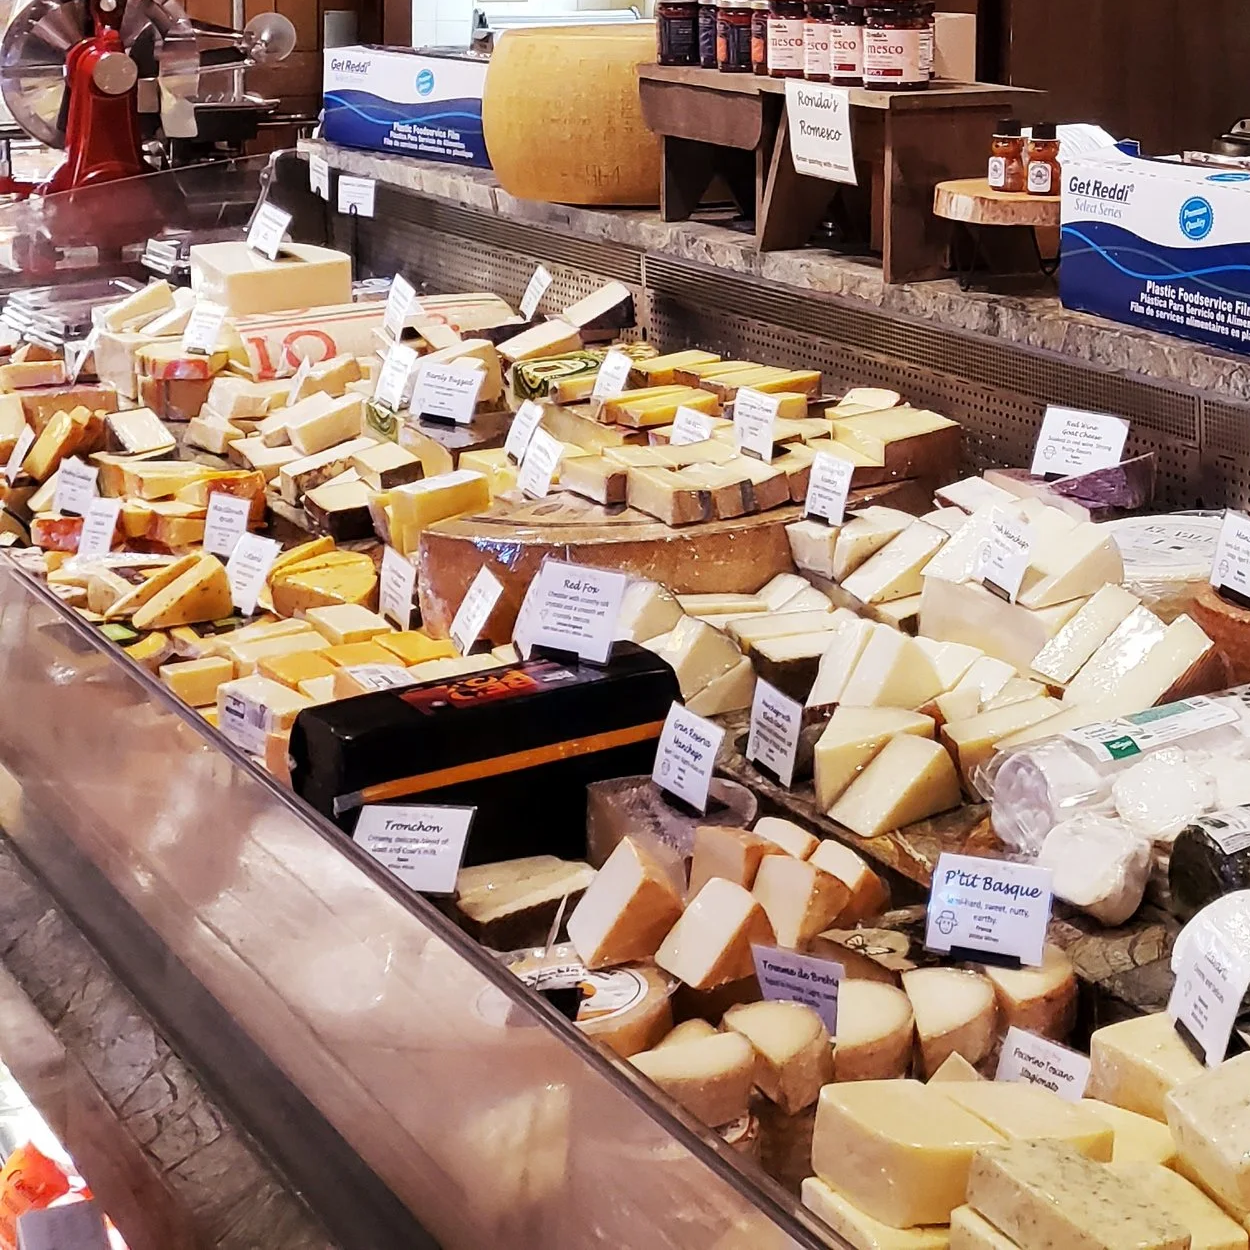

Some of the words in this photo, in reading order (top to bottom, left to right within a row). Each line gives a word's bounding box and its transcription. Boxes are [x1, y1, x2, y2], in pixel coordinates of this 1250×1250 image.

[797, 90, 840, 112] Ronda's
[799, 119, 842, 141] Romesco
[1069, 176, 1091, 196] Get
[1074, 197, 1097, 214] Select
[1100, 202, 1123, 219] Series
[1146, 280, 1177, 300] Plastic
[1178, 287, 1233, 313] Foodservice
[1130, 301, 1145, 314] Film
[1146, 305, 1155, 317] de
[1155, 309, 1184, 325] services
[1186, 316, 1229, 336] alimentaires
[1231, 328, 1240, 338] en
[1168, 299, 1185, 312] Para
[1186, 303, 1215, 321] Servicio
[1216, 311, 1226, 323] de
[563, 579, 582, 591] Red
[582, 582, 600, 594] Fox
[385, 820, 443, 833] Tronchon
[945, 869, 981, 888] P'tit
[982, 876, 1043, 901] Basque
[762, 959, 797, 977] Tomme
[797, 967, 810, 980] de
[1013, 1046, 1045, 1068] Pecorino
